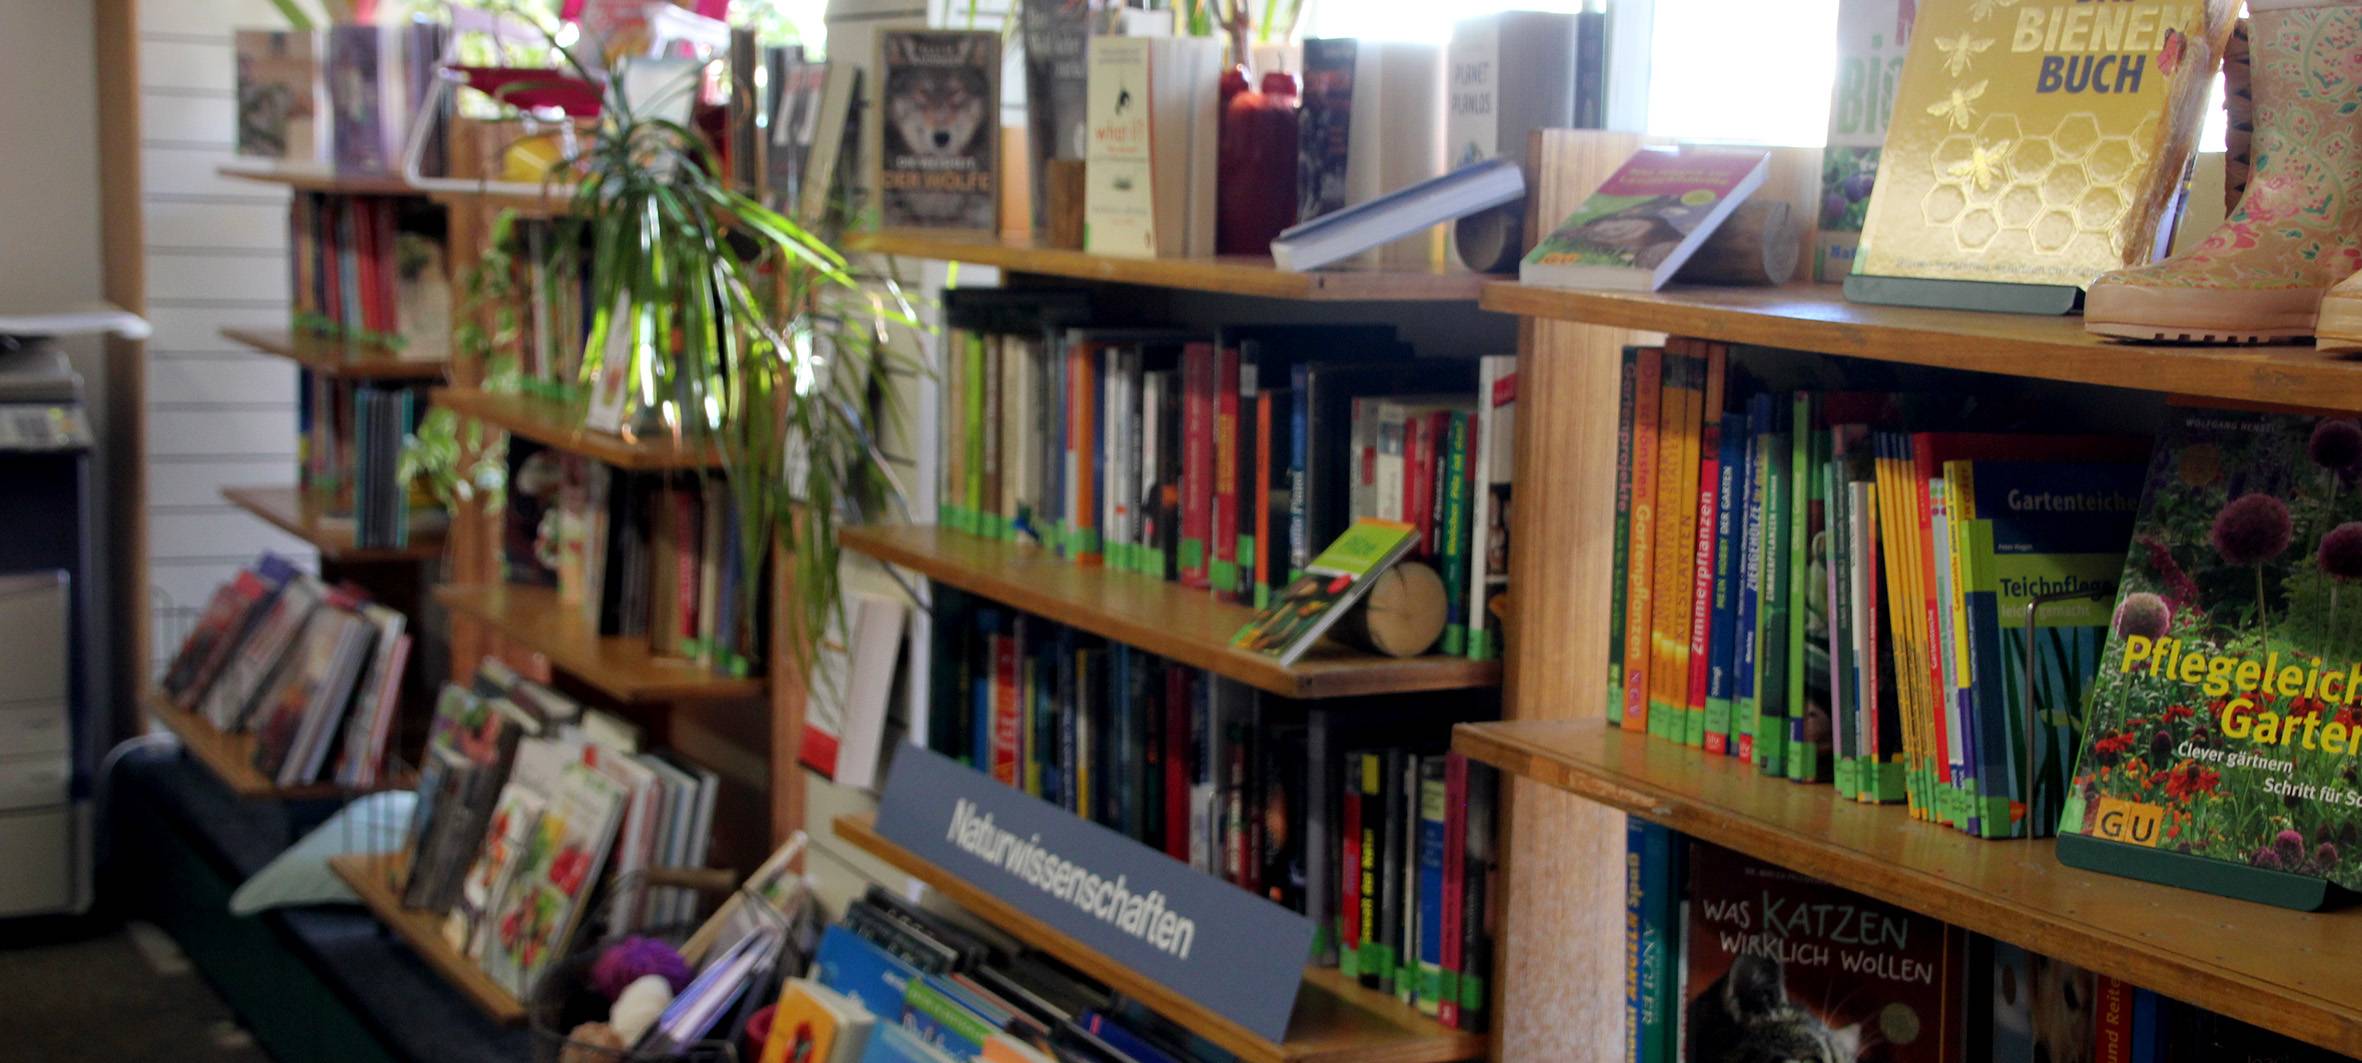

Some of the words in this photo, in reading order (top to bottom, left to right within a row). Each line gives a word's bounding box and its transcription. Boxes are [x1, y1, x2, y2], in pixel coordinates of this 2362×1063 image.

[2011, 4, 2194, 53] BIENEN
[1455, 62, 1489, 86] PLANET
[2036, 54, 2147, 95] BUCH
[883, 170, 919, 190] DER
[1617, 362, 1637, 511] Gartenprojekte
[1637, 403, 1653, 499] schönsten
[1720, 465, 1733, 509] GARTEN
[2007, 488, 2140, 512] Gartenteiche
[1719, 511, 1731, 536] DER
[1746, 503, 1761, 592] ZIERGEHÖLZE
[1630, 503, 1652, 660] Gartenpflanzen
[1691, 491, 1713, 656] Zimmerpflanzen
[1765, 513, 1777, 603] ZIMMERPFLANZEN
[1950, 555, 1962, 612] Gartenteiche
[2000, 576, 2115, 602] Teichpflege
[1927, 608, 1940, 671] Gartenteiche
[2177, 741, 2225, 765] Clever
[2263, 777, 2317, 801] Schritt
[2319, 782, 2342, 804] für
[2101, 810, 2154, 843] GU
[947, 797, 1197, 962] Naturwissenschaften
[1702, 895, 1751, 928] WAS
[1761, 889, 1909, 950] KATZEN
[1719, 929, 1830, 971] WIRKLICH
[1839, 949, 1935, 986] WOLLEN
[2104, 973, 2121, 1026] Reite
